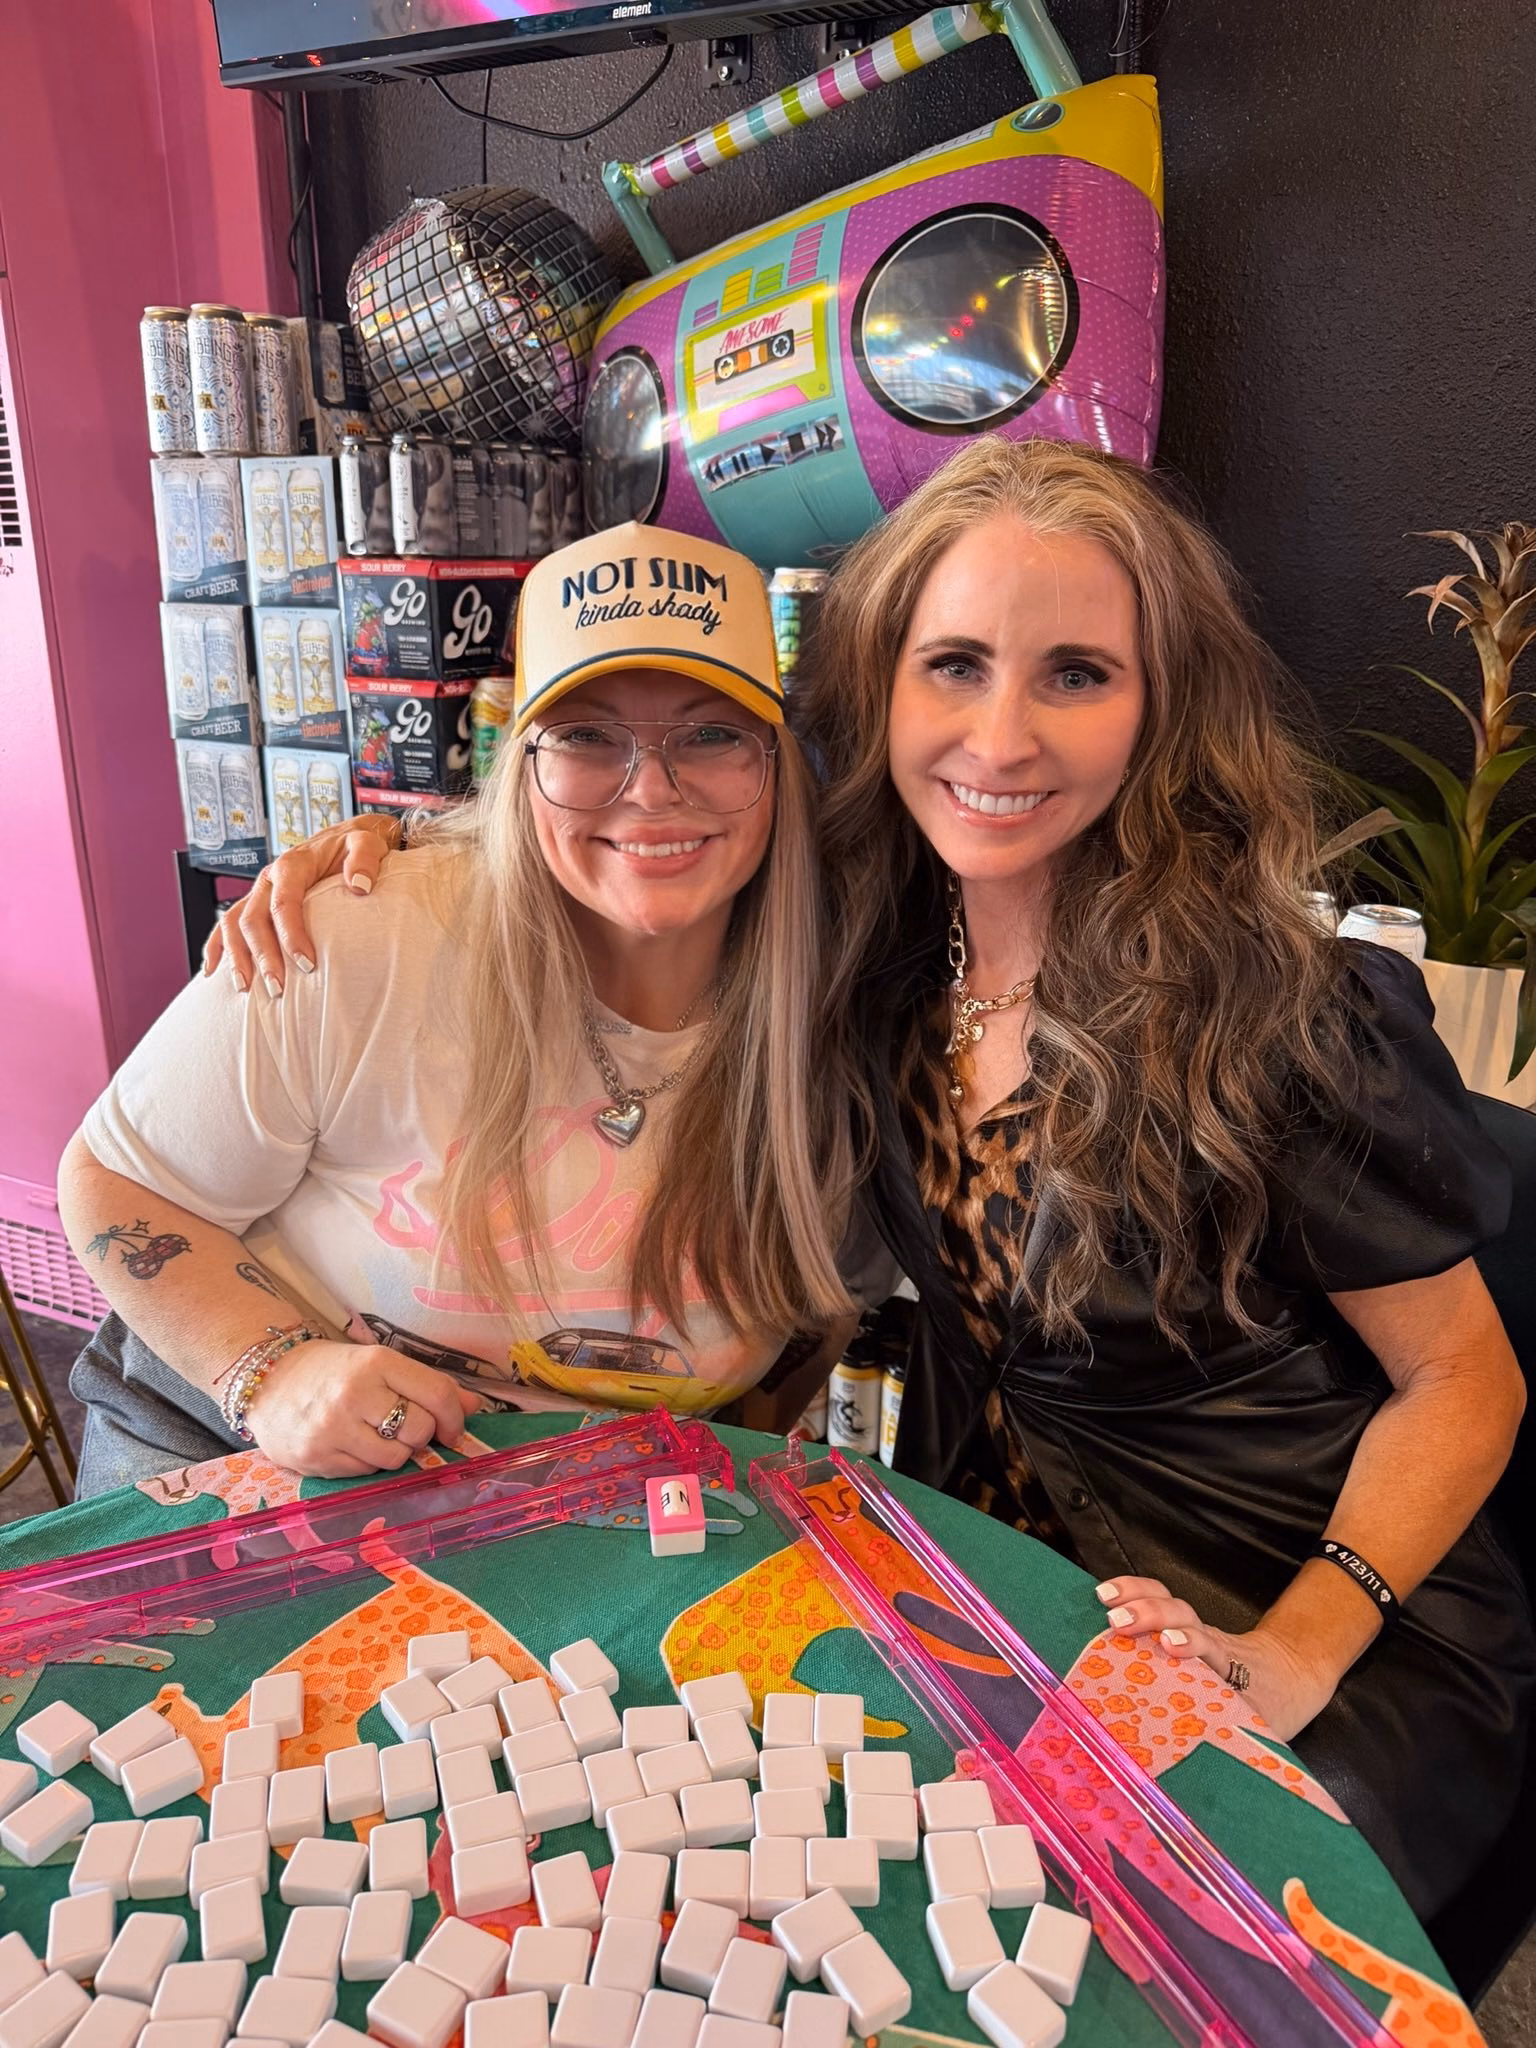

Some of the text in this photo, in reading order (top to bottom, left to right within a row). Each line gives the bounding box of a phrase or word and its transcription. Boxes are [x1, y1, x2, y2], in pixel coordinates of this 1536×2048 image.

[612, 2, 652, 19] element
[360, 563, 407, 573] SOUR BERRY
[209, 579, 240, 598] BEER
[562, 556, 728, 609] NOT SLIM
[575, 593, 645, 631] kinda
[648, 591, 722, 636] shady
[367, 682, 413, 693] SOUR BERRY
[214, 719, 242, 736] BEER
[379, 793, 400, 802] SOUR
[231, 851, 259, 867] BEER
[1337, 1551, 1381, 1590] 4/23/11
